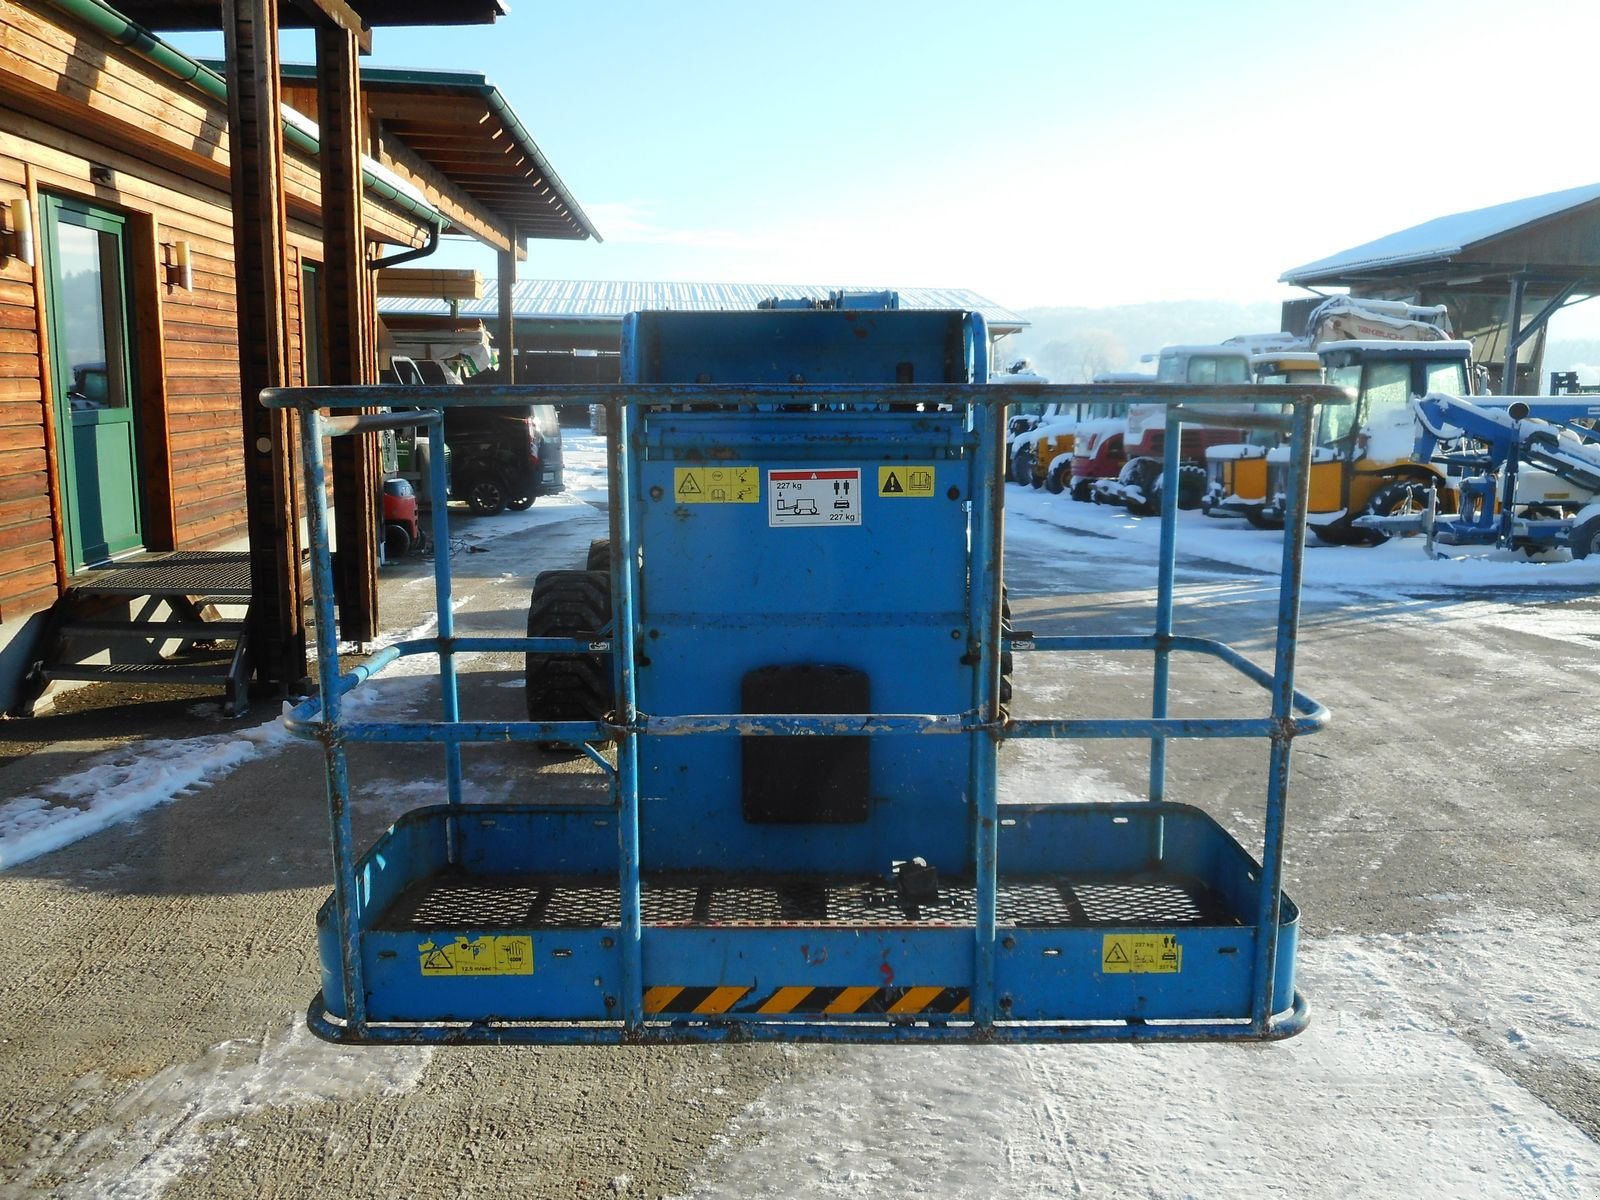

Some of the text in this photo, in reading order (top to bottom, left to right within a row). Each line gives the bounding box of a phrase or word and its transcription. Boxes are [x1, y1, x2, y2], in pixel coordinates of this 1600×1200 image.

[776, 482, 802, 490] 227 kg
[829, 513, 855, 521] 227 kg
